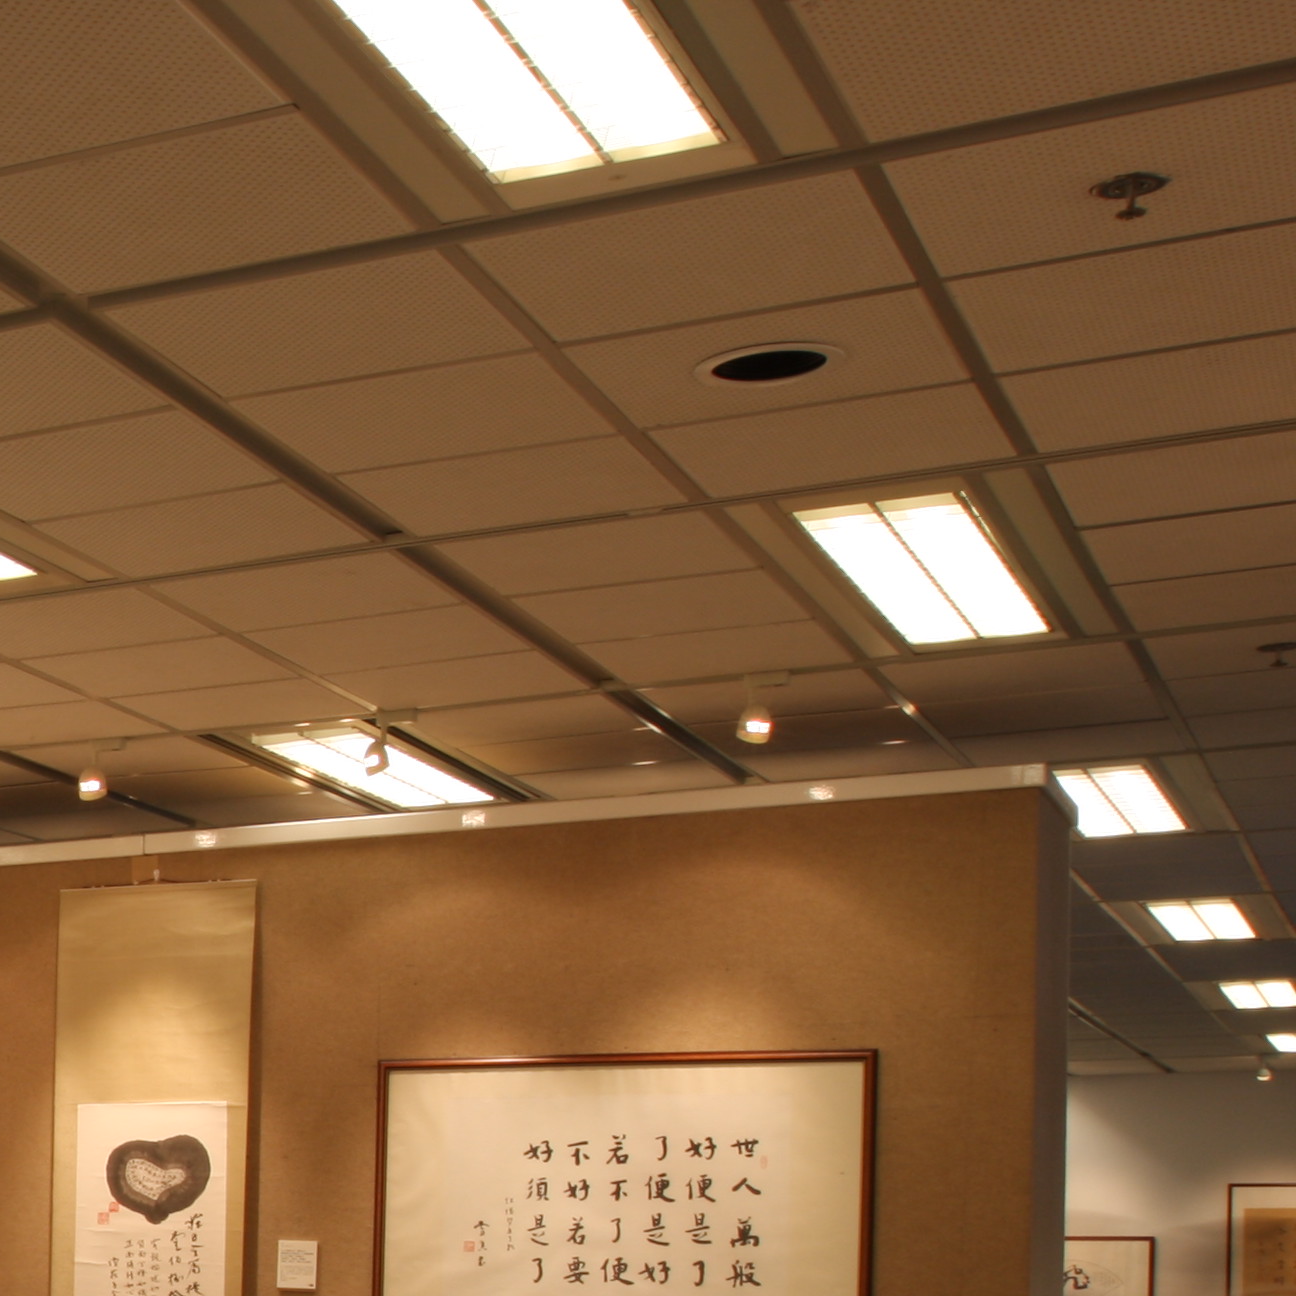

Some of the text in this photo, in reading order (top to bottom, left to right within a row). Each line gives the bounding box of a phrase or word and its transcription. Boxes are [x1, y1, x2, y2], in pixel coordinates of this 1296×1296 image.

[523, 1139, 554, 1284] 好須是了
[563, 1140, 591, 1285] 不好若要
[600, 1134, 635, 1286] 若不了便
[638, 1135, 676, 1285] 了便是好
[684, 1136, 718, 1288] 好便是了
[725, 1138, 762, 1288] 世人萬般
